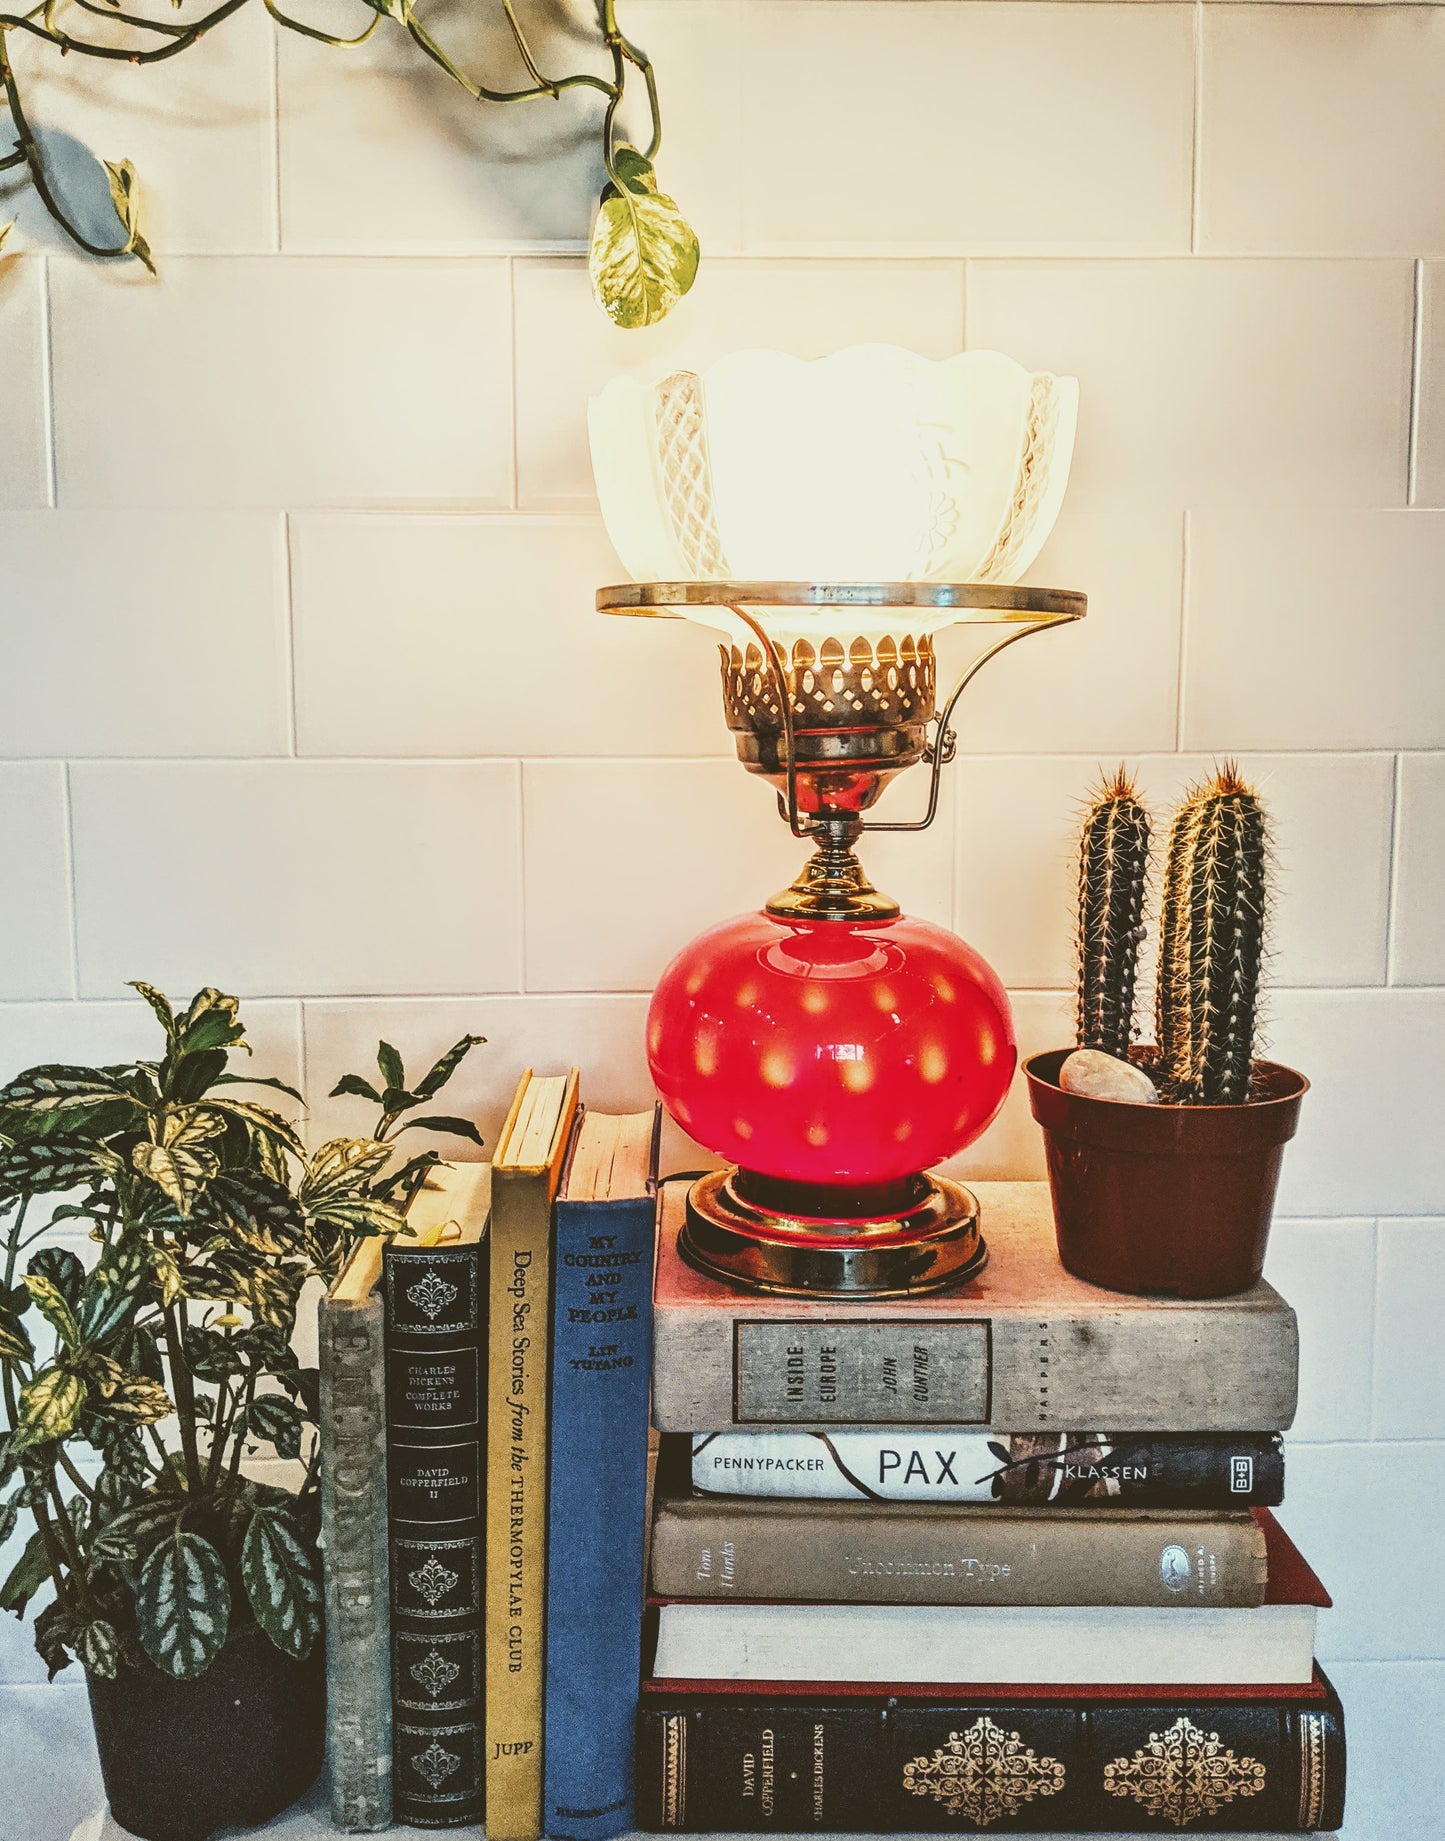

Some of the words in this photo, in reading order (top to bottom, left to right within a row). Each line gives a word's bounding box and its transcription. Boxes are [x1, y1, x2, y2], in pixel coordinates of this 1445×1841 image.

[588, 1235, 618, 1249] MY
[563, 1251, 642, 1268] COUNTRY
[508, 1250, 533, 1298] Deep
[585, 1272, 623, 1287] AND
[588, 1290, 619, 1305] MY
[513, 1303, 531, 1332] Sea
[567, 1304, 639, 1324] PEOPLE
[569, 1355, 634, 1371] YUTANG
[588, 1344, 618, 1358] LIN
[408, 1366, 456, 1376] CHARLES
[512, 1337, 531, 1396] Stories
[787, 1346, 804, 1402] INSIDE
[820, 1346, 837, 1402] EUROPE
[883, 1357, 897, 1394] JOHN
[913, 1345, 929, 1402] GUNTHER
[1038, 1323, 1049, 1421] HARPERS
[409, 1376, 455, 1386] DICKENS
[406, 1390, 460, 1401] COMPLETE
[414, 1402, 453, 1411] WORKS
[506, 1397, 530, 1441] from
[511, 1446, 529, 1472] the
[713, 1456, 825, 1472] PENNYPACKER
[879, 1449, 959, 1485] PAX
[1065, 1464, 1148, 1480] KLASSEN
[400, 1476, 468, 1488] COPPERFIELD
[417, 1468, 450, 1477] DAVID
[429, 1490, 438, 1499] II
[509, 1476, 524, 1617] THERMOPYLAE
[697, 1548, 711, 1581] Tom
[720, 1541, 735, 1588] Hanks
[961, 1558, 1012, 1582] Type
[508, 1625, 523, 1674] CLUB
[494, 1741, 533, 1760] JUPP
[813, 1724, 824, 1775] DICKENS
[742, 1753, 755, 1796] DAVID
[761, 1728, 774, 1817] COPPERFIELD
[813, 1775, 824, 1821] CHARLES
